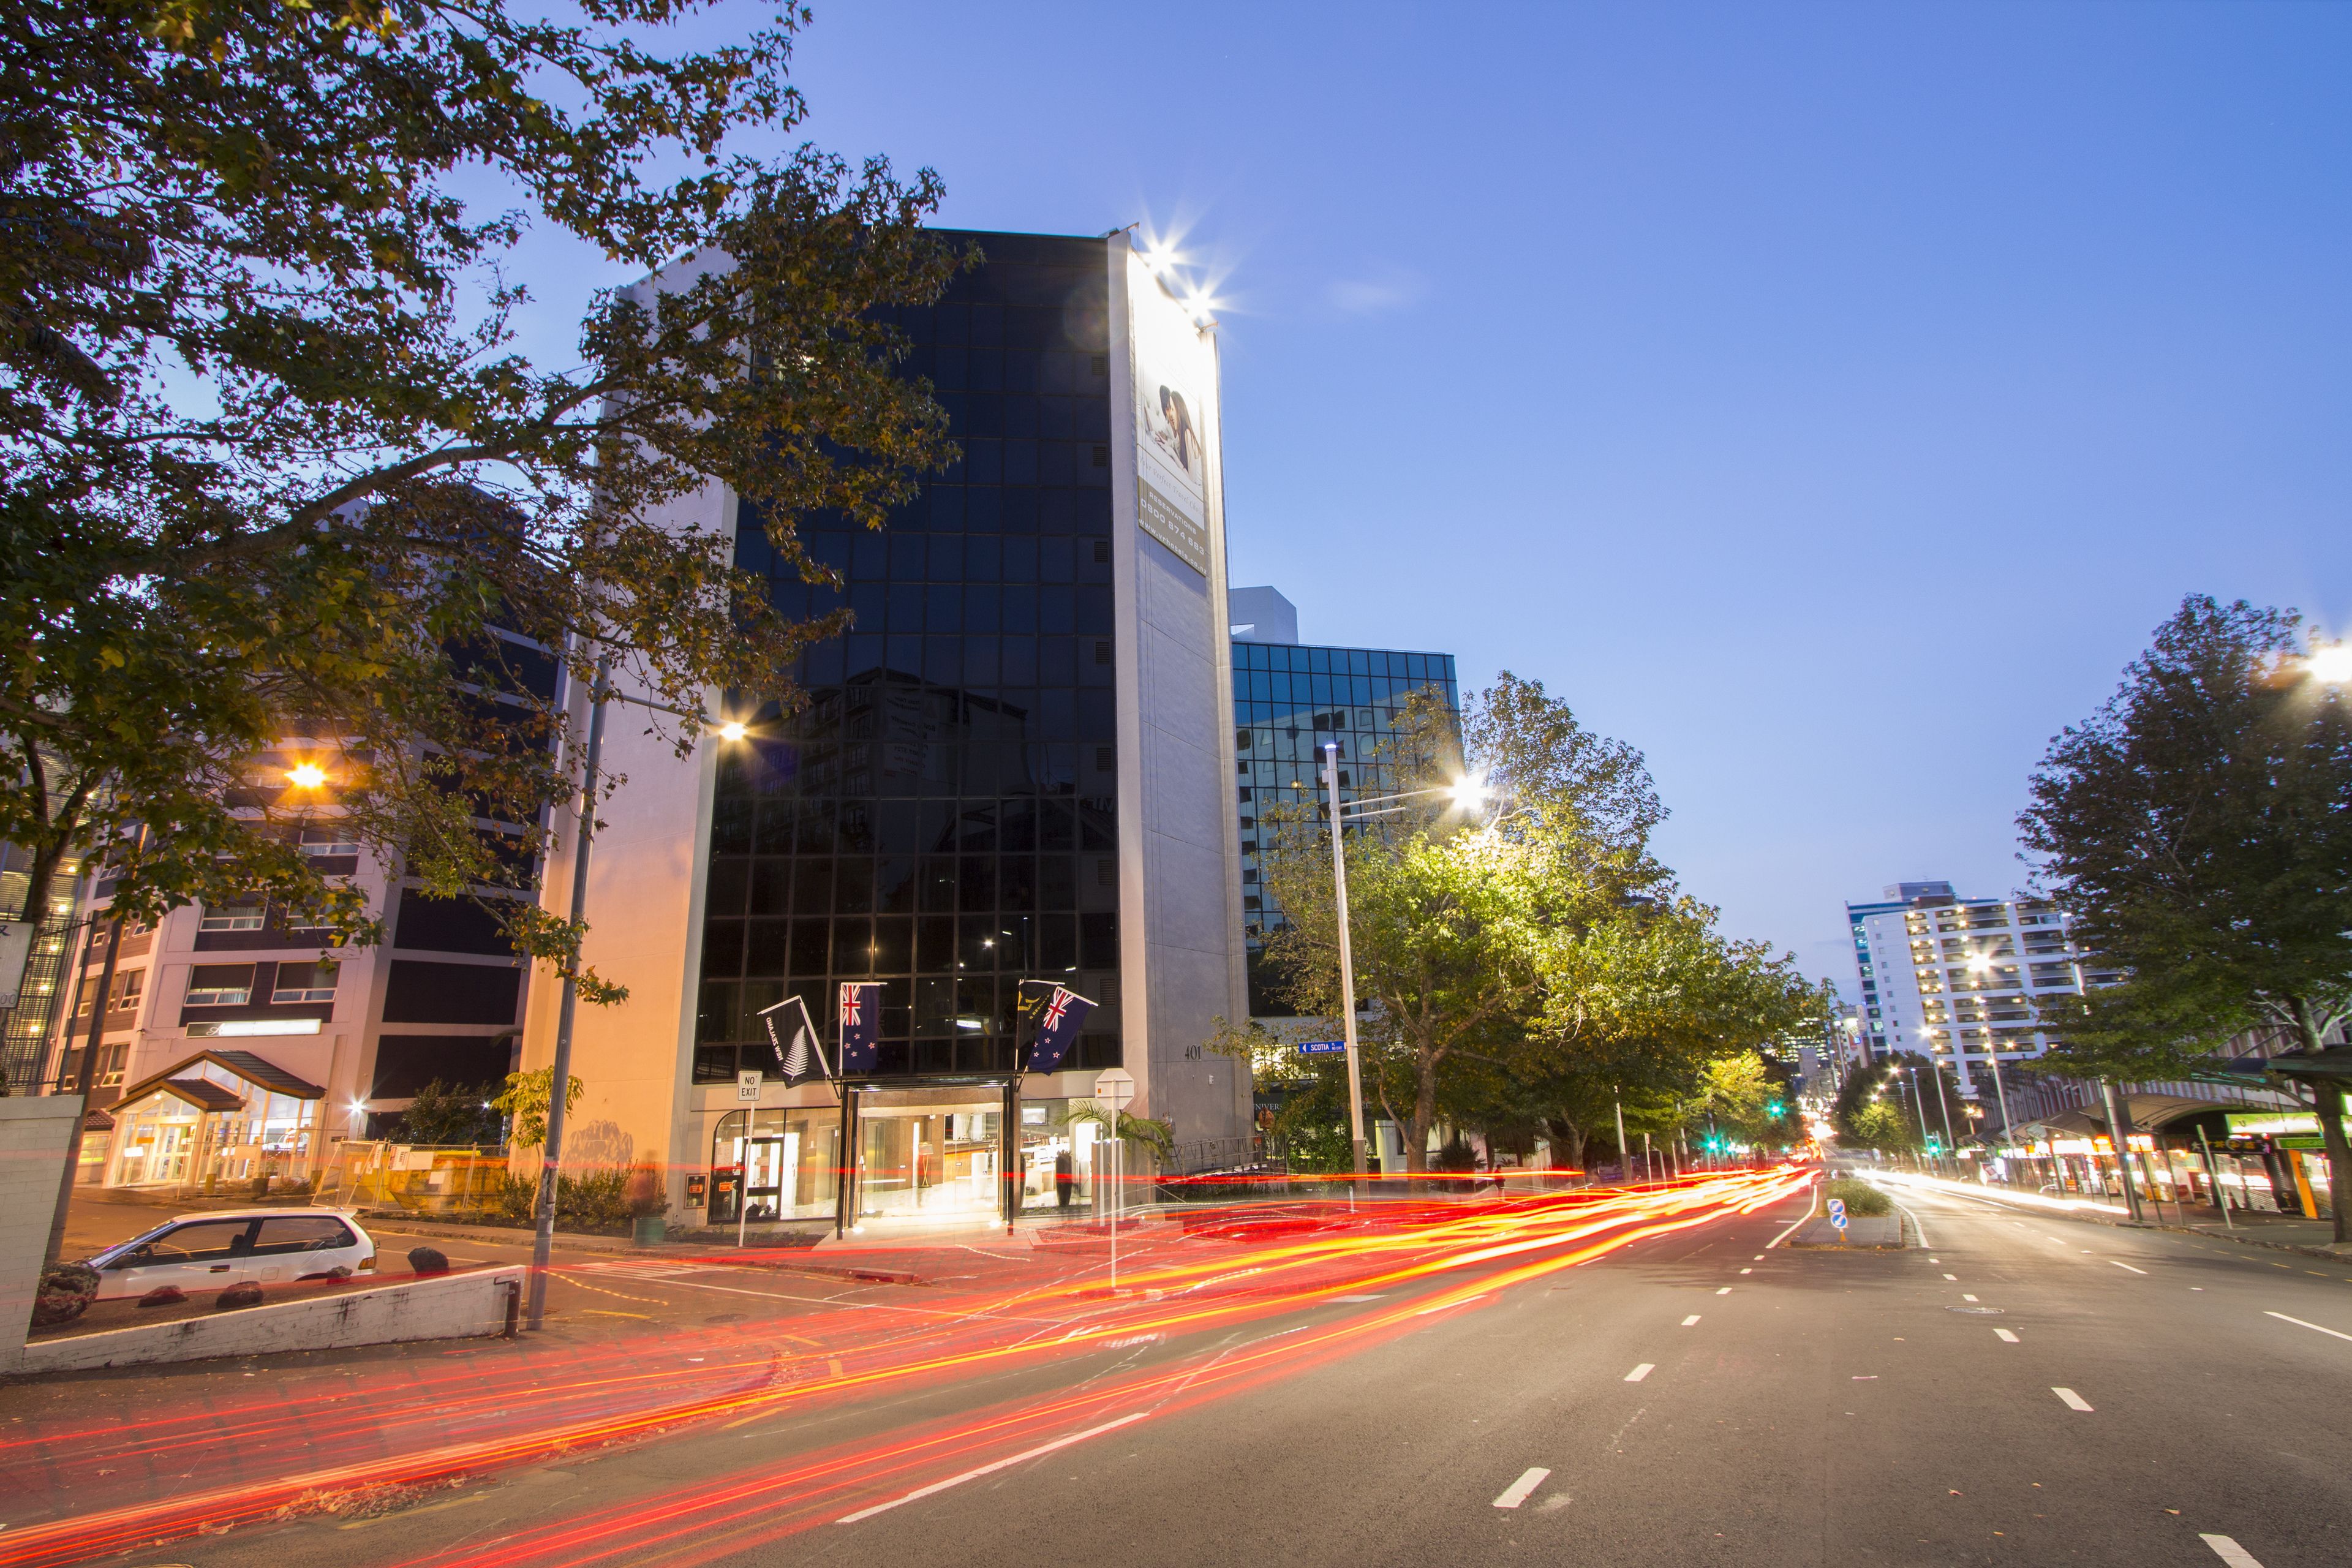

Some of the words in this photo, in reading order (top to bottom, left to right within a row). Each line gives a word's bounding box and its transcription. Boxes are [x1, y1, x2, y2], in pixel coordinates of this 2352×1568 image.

[1140, 498, 1165, 524] 0800
[1168, 521, 1186, 540] 874
[1188, 537, 1205, 556] 683
[1149, 491, 1196, 535] RESERVATIONS
[1139, 518, 1207, 575] www.vrhotels.co.nz
[1185, 1044, 1200, 1060] 401
[741, 1088, 756, 1096] EXIT
[745, 1076, 755, 1085] NO
